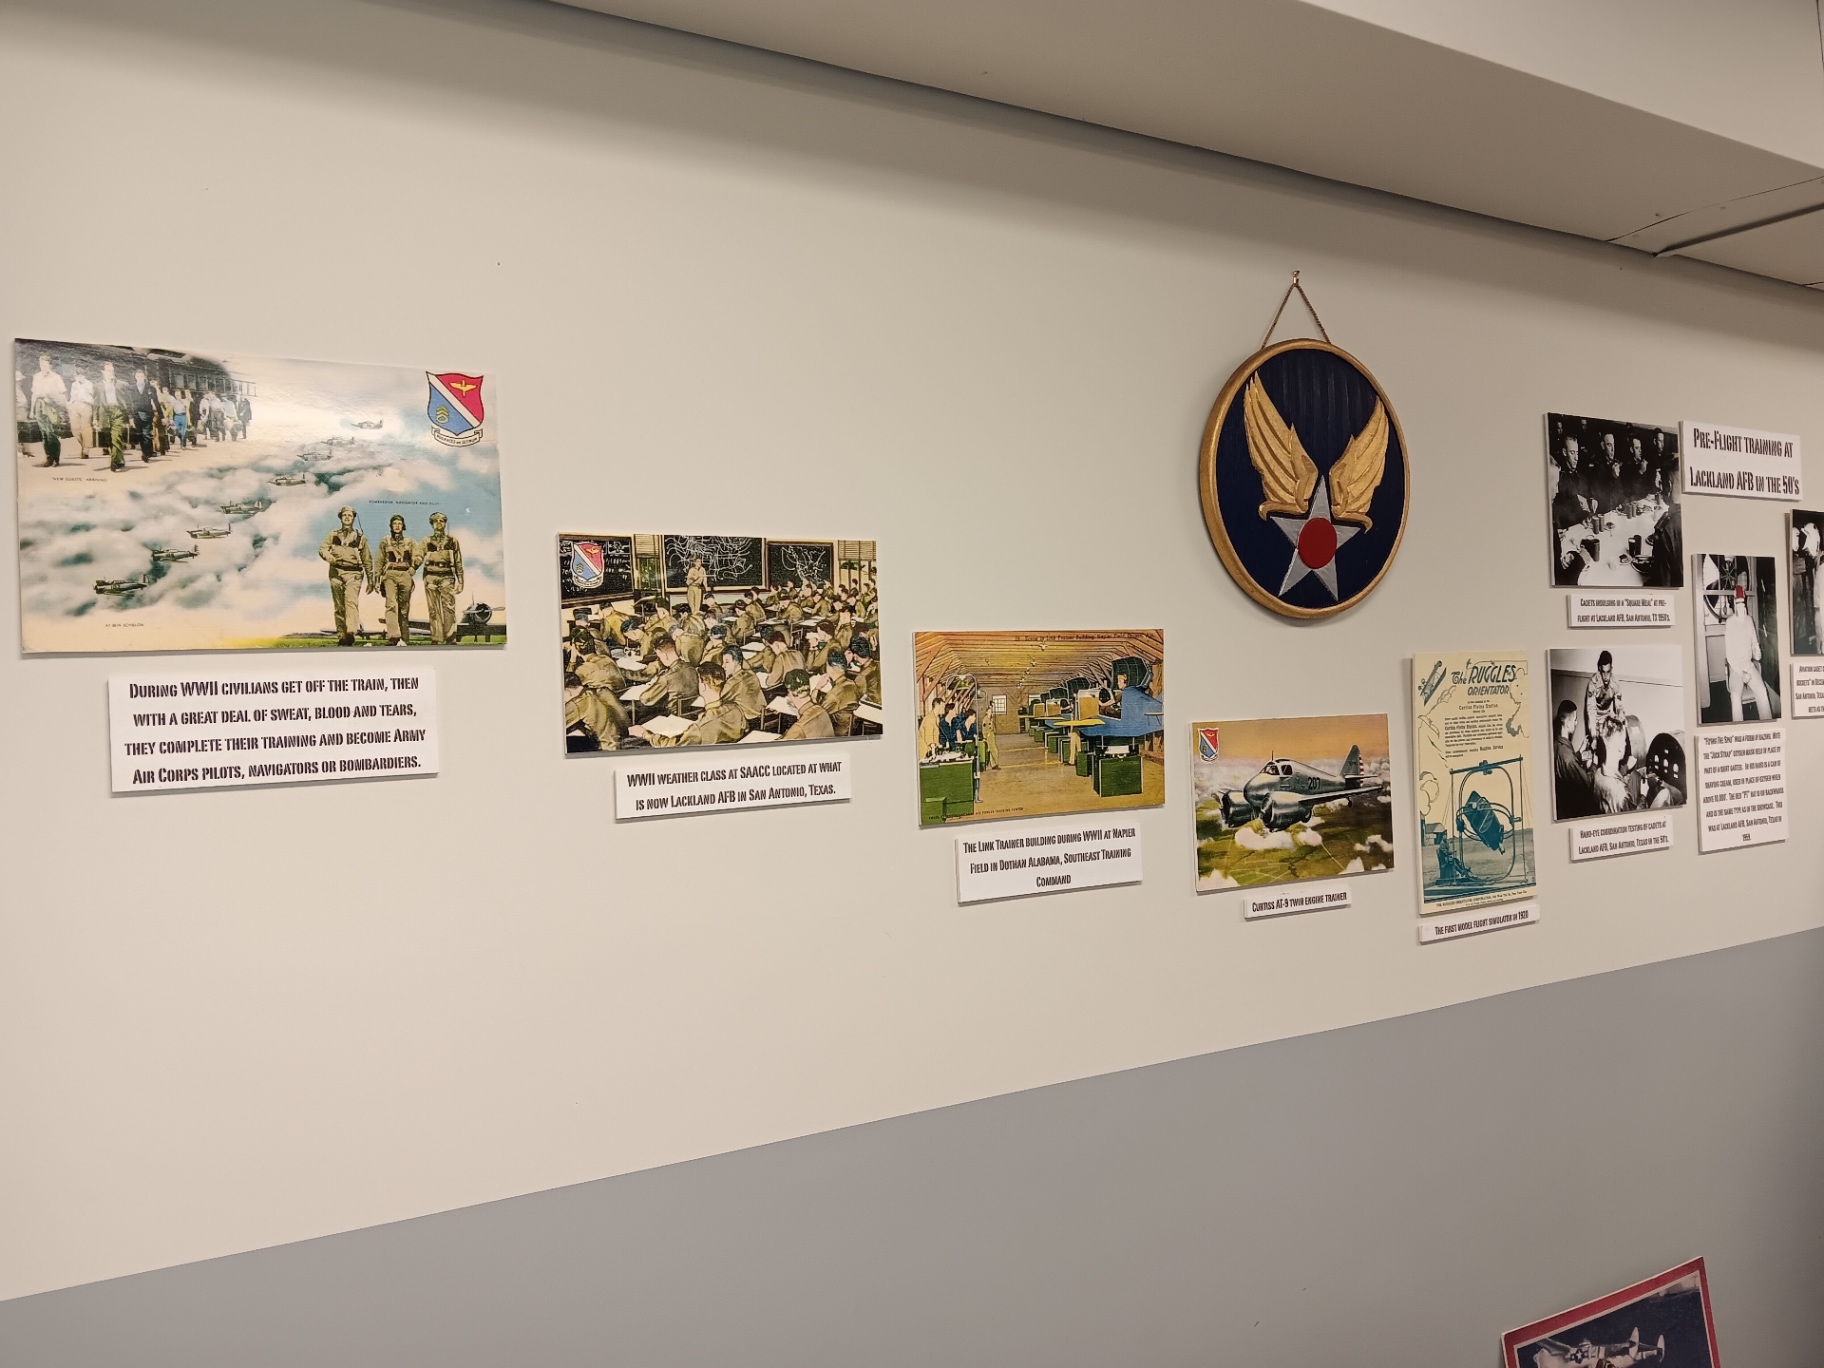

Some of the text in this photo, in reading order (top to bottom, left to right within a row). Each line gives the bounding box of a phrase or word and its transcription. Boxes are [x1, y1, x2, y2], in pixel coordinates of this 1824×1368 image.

[1694, 428, 1793, 458] PRE-FLIGHT TRAINING AT
[1690, 467, 1734, 489] LACKLAND
[1737, 471, 1754, 490] AFB
[1756, 476, 1764, 492] IN
[1766, 477, 1781, 493] THE
[1451, 665, 1516, 684] The RUGGLES
[130, 677, 418, 698] DURING WWII CIVILIANS GET OFF THE TRAIN, THEN
[1467, 685, 1510, 696] ORIENTATOR
[133, 704, 416, 727] WITH A GREAT DEAL OF SWEAT, BLOOD AND TEARS,
[125, 729, 425, 755] THEY COMPLETE THEIR TRAINING AND BECOME ARMY
[133, 756, 421, 784] AIR CORPS PILOTS, NAVIGATORS OR BOMBARDIERS.
[627, 762, 842, 787] WWII WEATHER CLASS AT SAACC LOCATED AT WHAT
[636, 784, 835, 810] IS NOW LACKLAND AFB IN SAN ANTONIO, TEXAS.
[963, 828, 1135, 853] THE LINK TRAINER BUILDING DURING WWII AT NAPIER
[971, 848, 1131, 874] FIELD IN DOTHAN ALABAMA, SOUTHEAST TRAINING
[1037, 875, 1071, 887] COMMAND
[1252, 900, 1274, 912] CURTISS
[1276, 898, 1289, 909] AT-9
[1325, 892, 1347, 903] TRAINER
[1435, 925, 1444, 935] THE
[1445, 923, 1457, 933] FIRST
[1458, 920, 1473, 931] MODEL
[1513, 912, 1517, 921] IN
